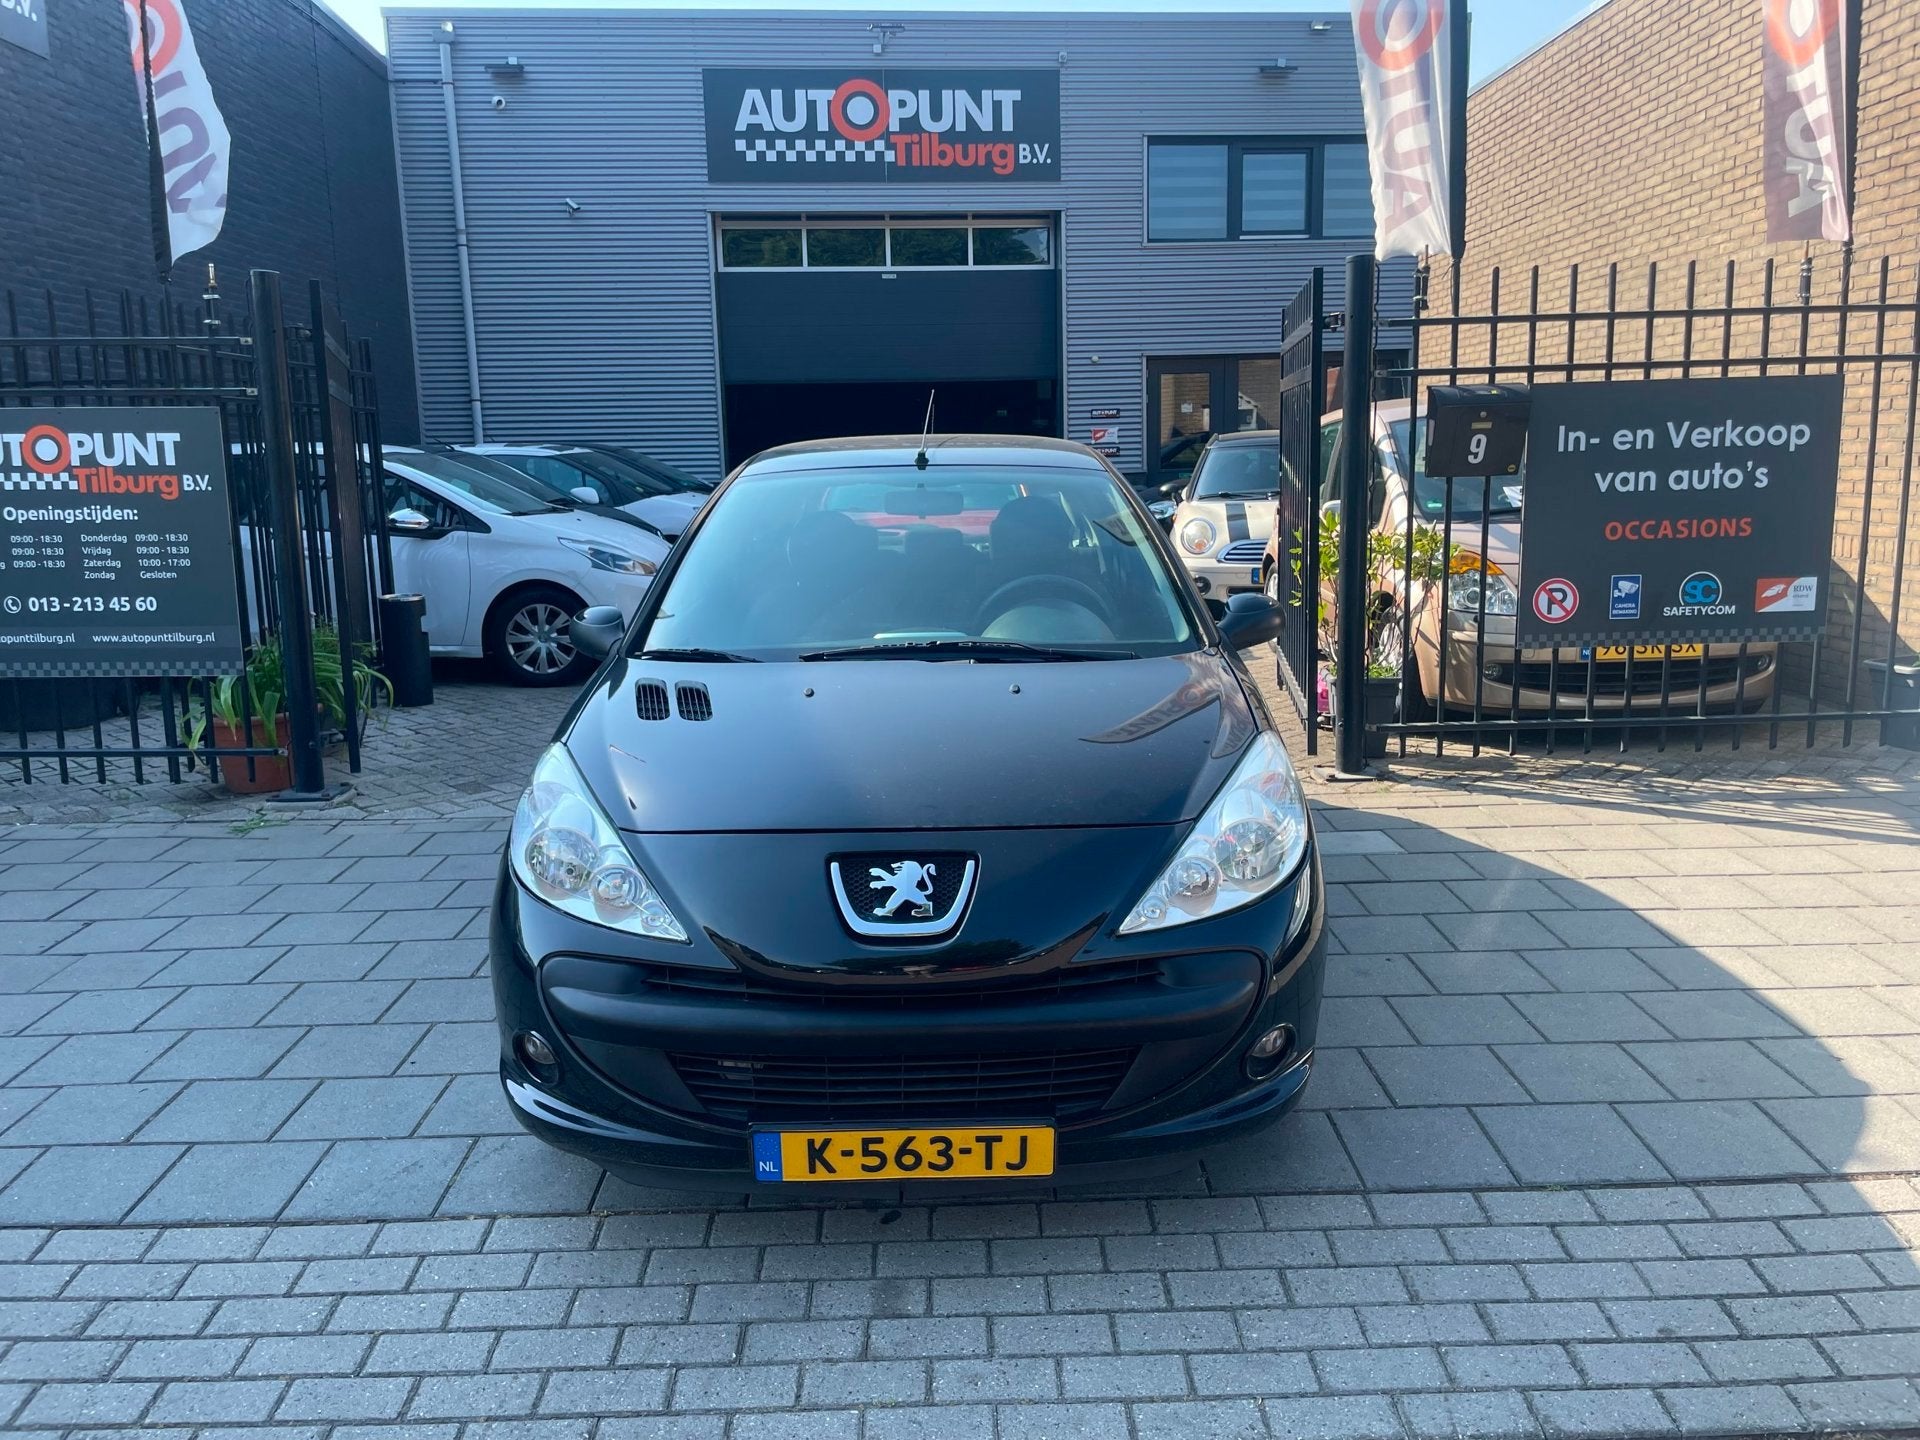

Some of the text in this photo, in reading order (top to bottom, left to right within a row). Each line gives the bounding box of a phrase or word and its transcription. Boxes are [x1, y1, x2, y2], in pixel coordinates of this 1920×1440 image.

[735, 79, 1021, 142] AUTOPUNT
[890, 132, 1051, 175] Tilburg B.V.
[1558, 419, 1811, 452] In- en Verkoop
[0, 424, 181, 474] TOPUNT
[1467, 433, 1487, 464] 9
[73, 466, 212, 500] Tilburg B.V.
[1595, 461, 1769, 493] van auto's
[3, 505, 139, 524] Openingstijden:
[1604, 517, 1752, 541] OCCASIONS
[10, 535, 34, 543] 09:00
[41, 535, 63, 543] 18:30
[80, 533, 128, 544] Donderdag
[135, 534, 159, 542] 09:00
[165, 534, 188, 542] 18:30
[12, 547, 35, 555] 09:00
[42, 547, 64, 555] 18:30
[82, 546, 112, 556] Vrijdag
[136, 546, 160, 554] 09:00
[167, 546, 190, 554] 18:30
[13, 560, 36, 568] 09:00
[43, 560, 66, 568] 18:30
[83, 558, 121, 568] Zaterdag
[138, 559, 161, 567] 10:00
[168, 559, 191, 567] 17:00
[84, 571, 177, 580] Zondag Gesloten
[109, 597, 131, 612] 45
[135, 597, 157, 612] 60
[1663, 605, 1736, 616] SAFETYCOM
[92, 632, 215, 645] www.autopunttilburg.nl
[759, 1135, 1028, 1174] NL K-563-TJ
